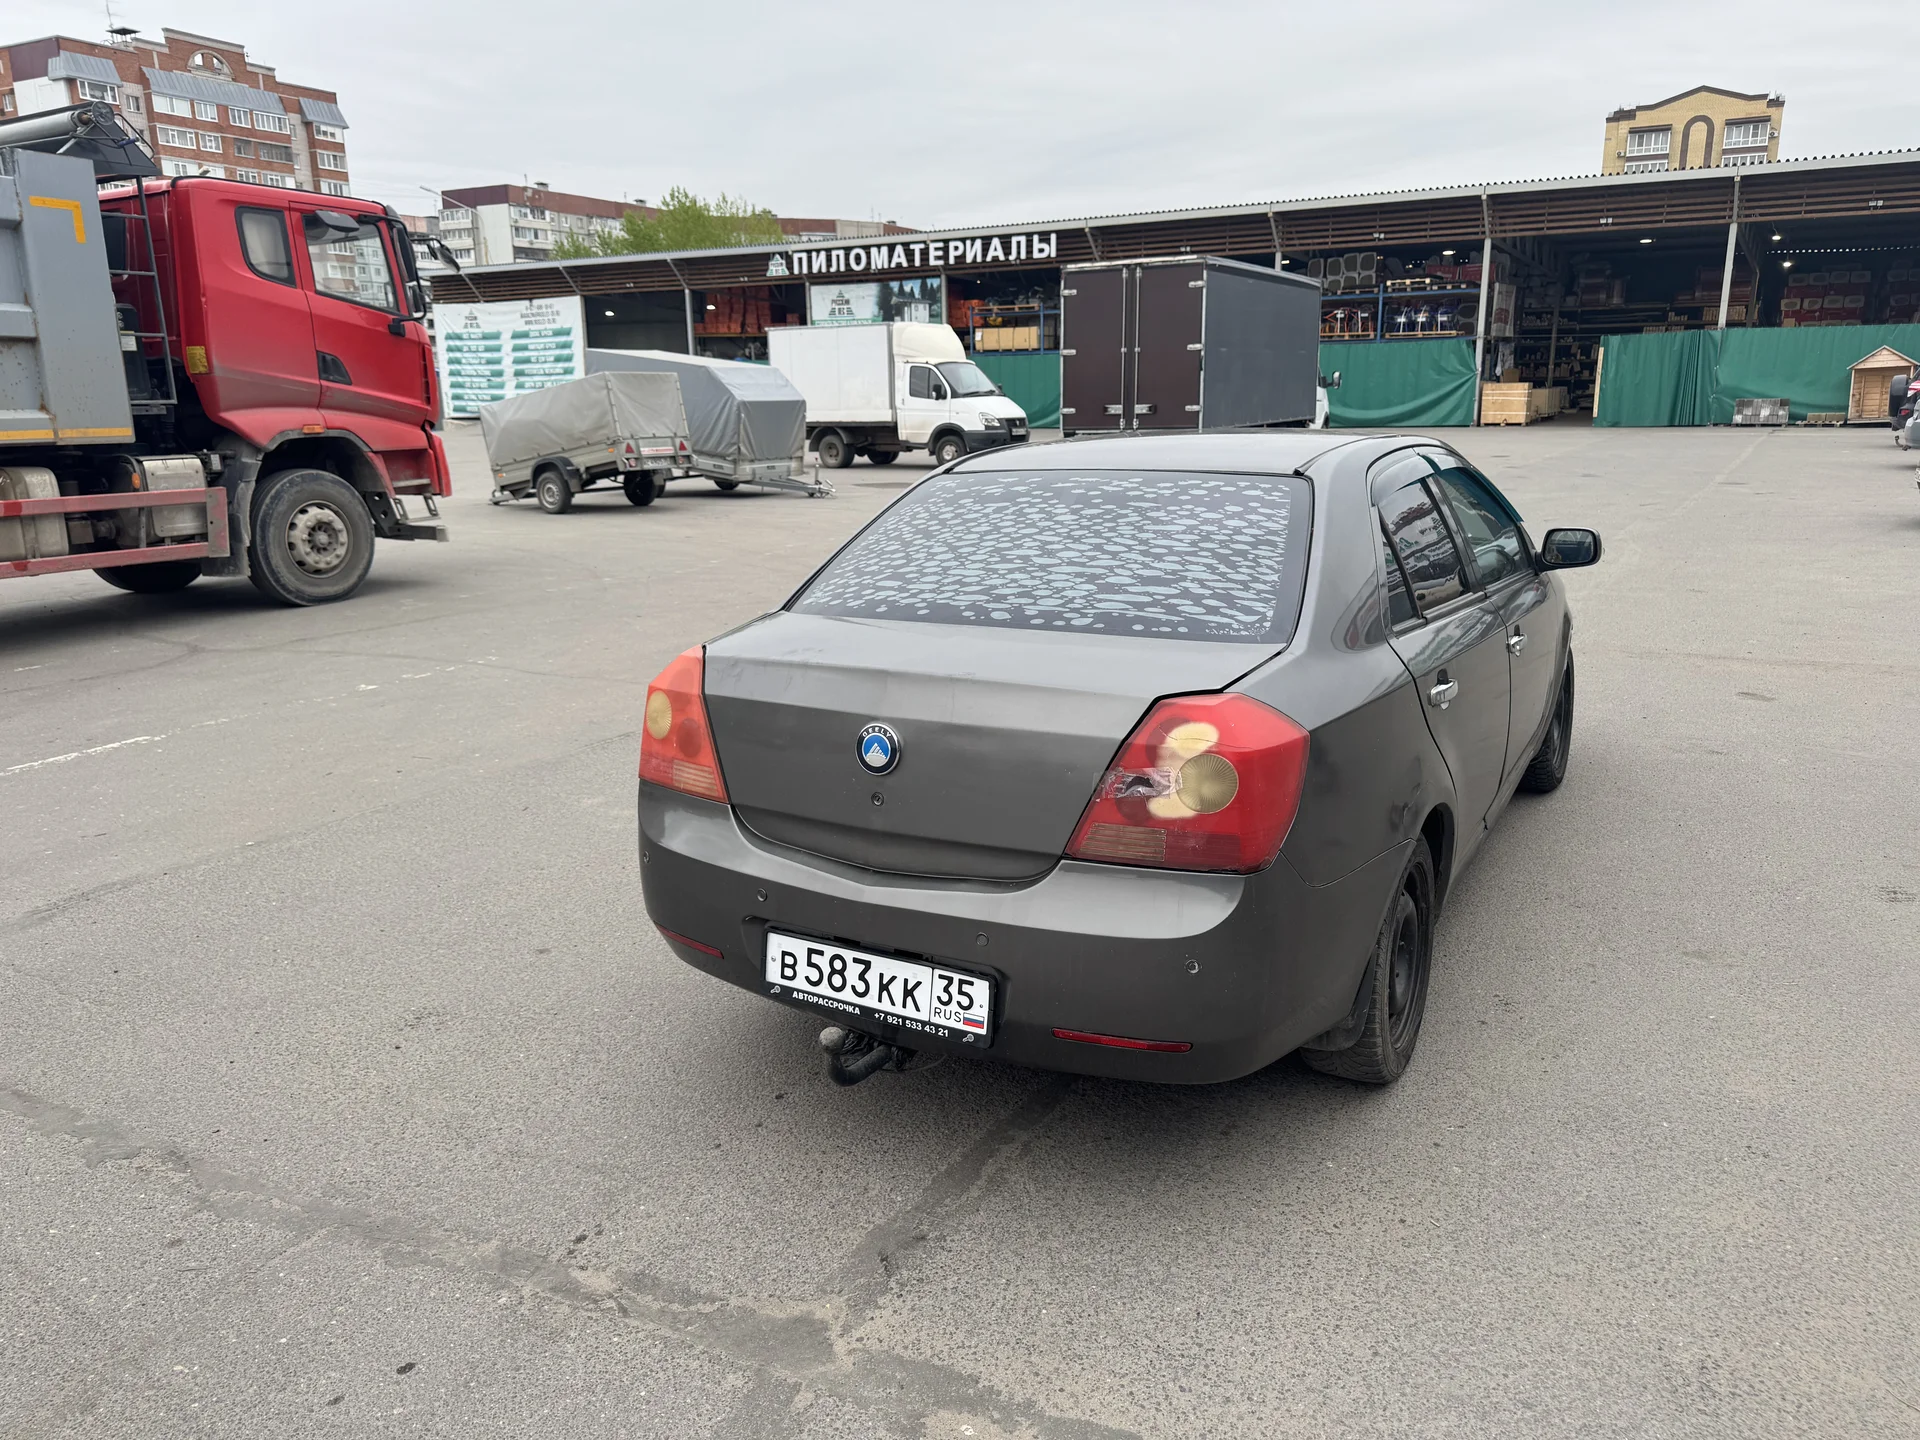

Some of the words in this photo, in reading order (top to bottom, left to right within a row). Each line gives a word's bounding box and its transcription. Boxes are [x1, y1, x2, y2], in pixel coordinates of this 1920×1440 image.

[792, 232, 1058, 275] ПИЛОМАТЕРИАЛЫ
[780, 947, 923, 1013] В583КК
[936, 973, 975, 1012] 35
[792, 990, 861, 1015] АВТОРАССРОЧКА
[933, 1006, 962, 1023] RUS
[874, 1012, 885, 1021] +7
[887, 1015, 903, 1026] 921
[905, 1019, 922, 1031] 533
[924, 1023, 936, 1034] 43
[937, 1027, 949, 1038] 21
